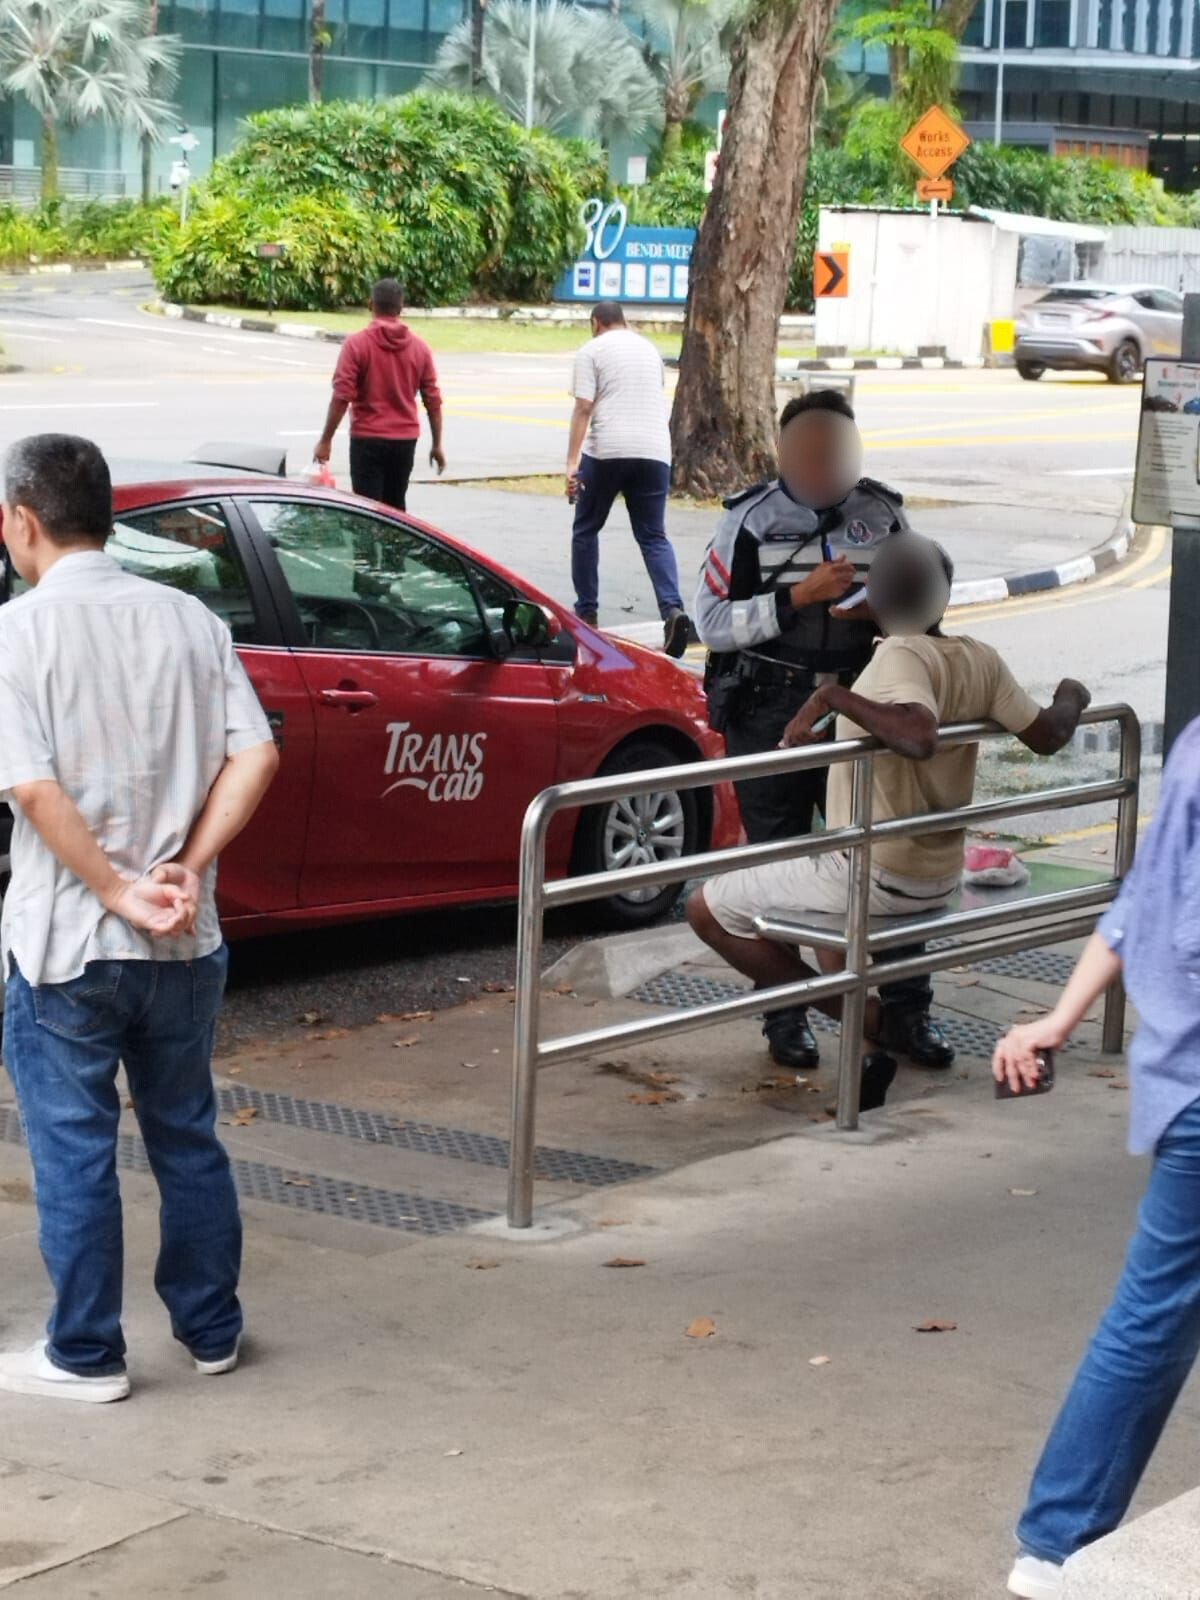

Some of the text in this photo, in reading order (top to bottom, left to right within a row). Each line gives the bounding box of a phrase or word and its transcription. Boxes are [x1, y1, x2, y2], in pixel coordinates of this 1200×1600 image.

[919, 131, 950, 143] Works
[916, 146, 953, 158] Access
[625, 242, 693, 260] BENDEMEE
[428, 762, 484, 802] cab
